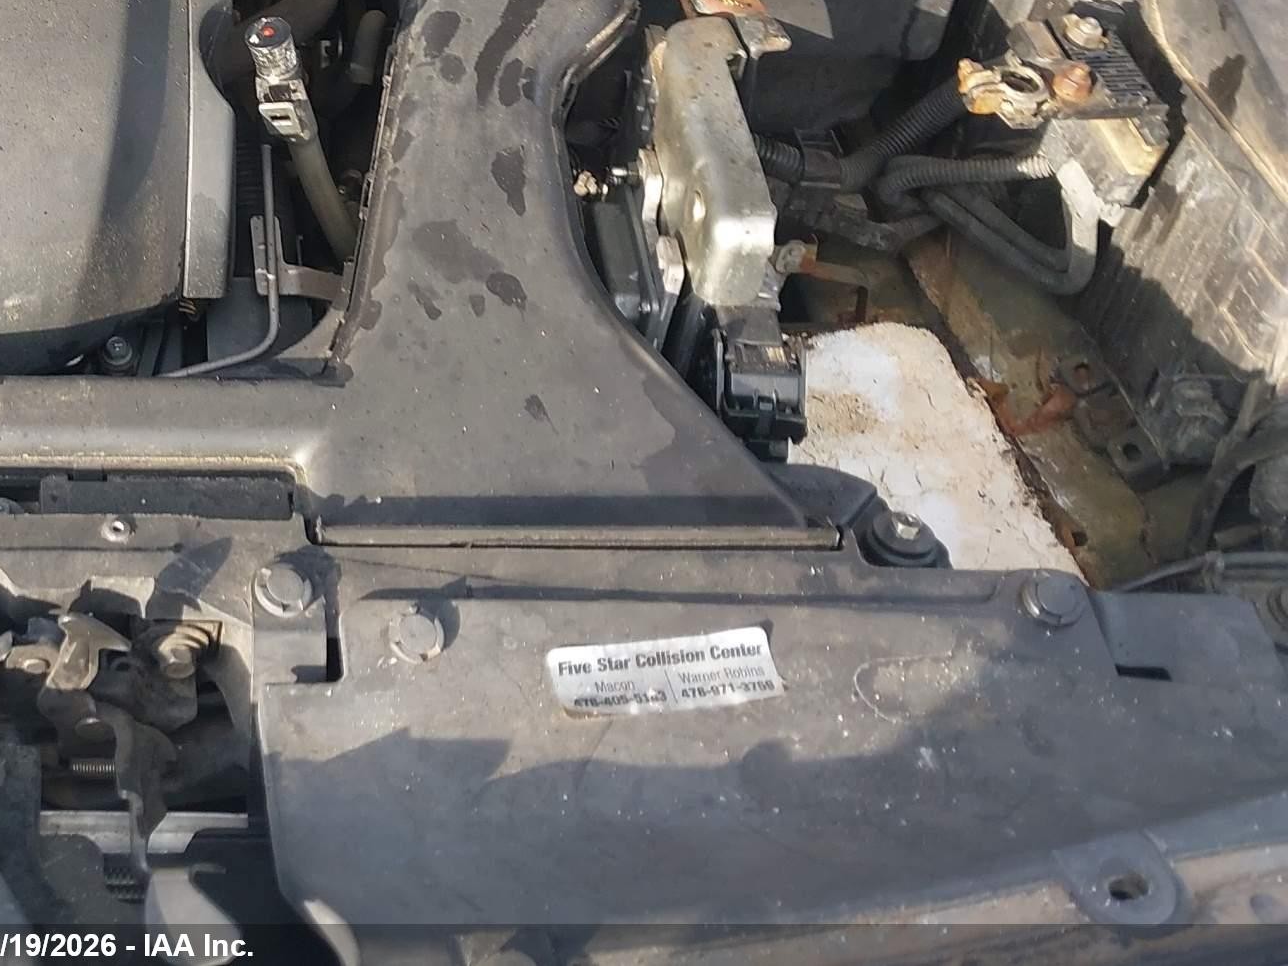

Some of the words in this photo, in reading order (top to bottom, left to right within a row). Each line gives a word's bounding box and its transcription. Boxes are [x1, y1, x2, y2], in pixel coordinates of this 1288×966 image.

[558, 660, 592, 677] Five
[597, 657, 631, 673] Star
[635, 650, 706, 669] Collision
[710, 643, 762, 661] Center
[678, 670, 722, 685] Warner
[723, 664, 766, 680] Robins
[594, 678, 636, 694] Macon
